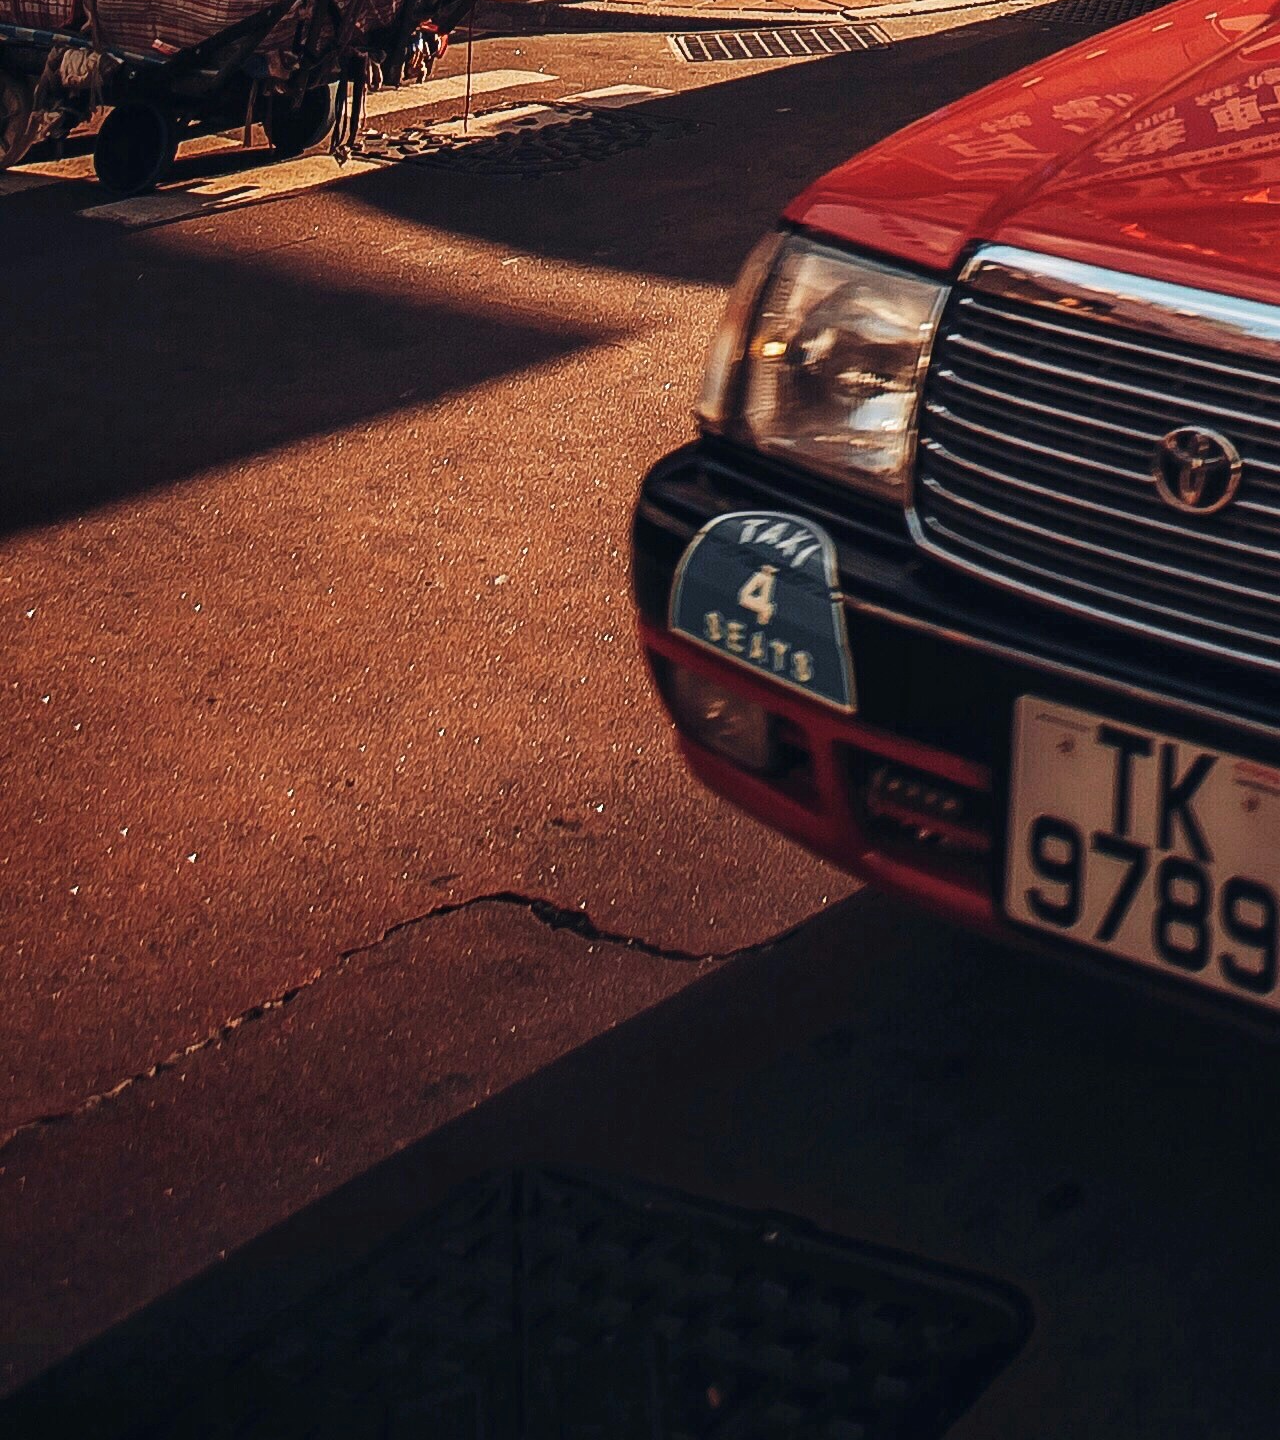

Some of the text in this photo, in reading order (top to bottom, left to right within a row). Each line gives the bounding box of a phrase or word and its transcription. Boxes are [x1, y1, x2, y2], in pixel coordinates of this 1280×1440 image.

[738, 519, 822, 569] TAXI
[738, 564, 780, 625] 4
[704, 610, 814, 682] SEATS
[1096, 722, 1219, 864] TK
[1023, 813, 1280, 998] 9789
